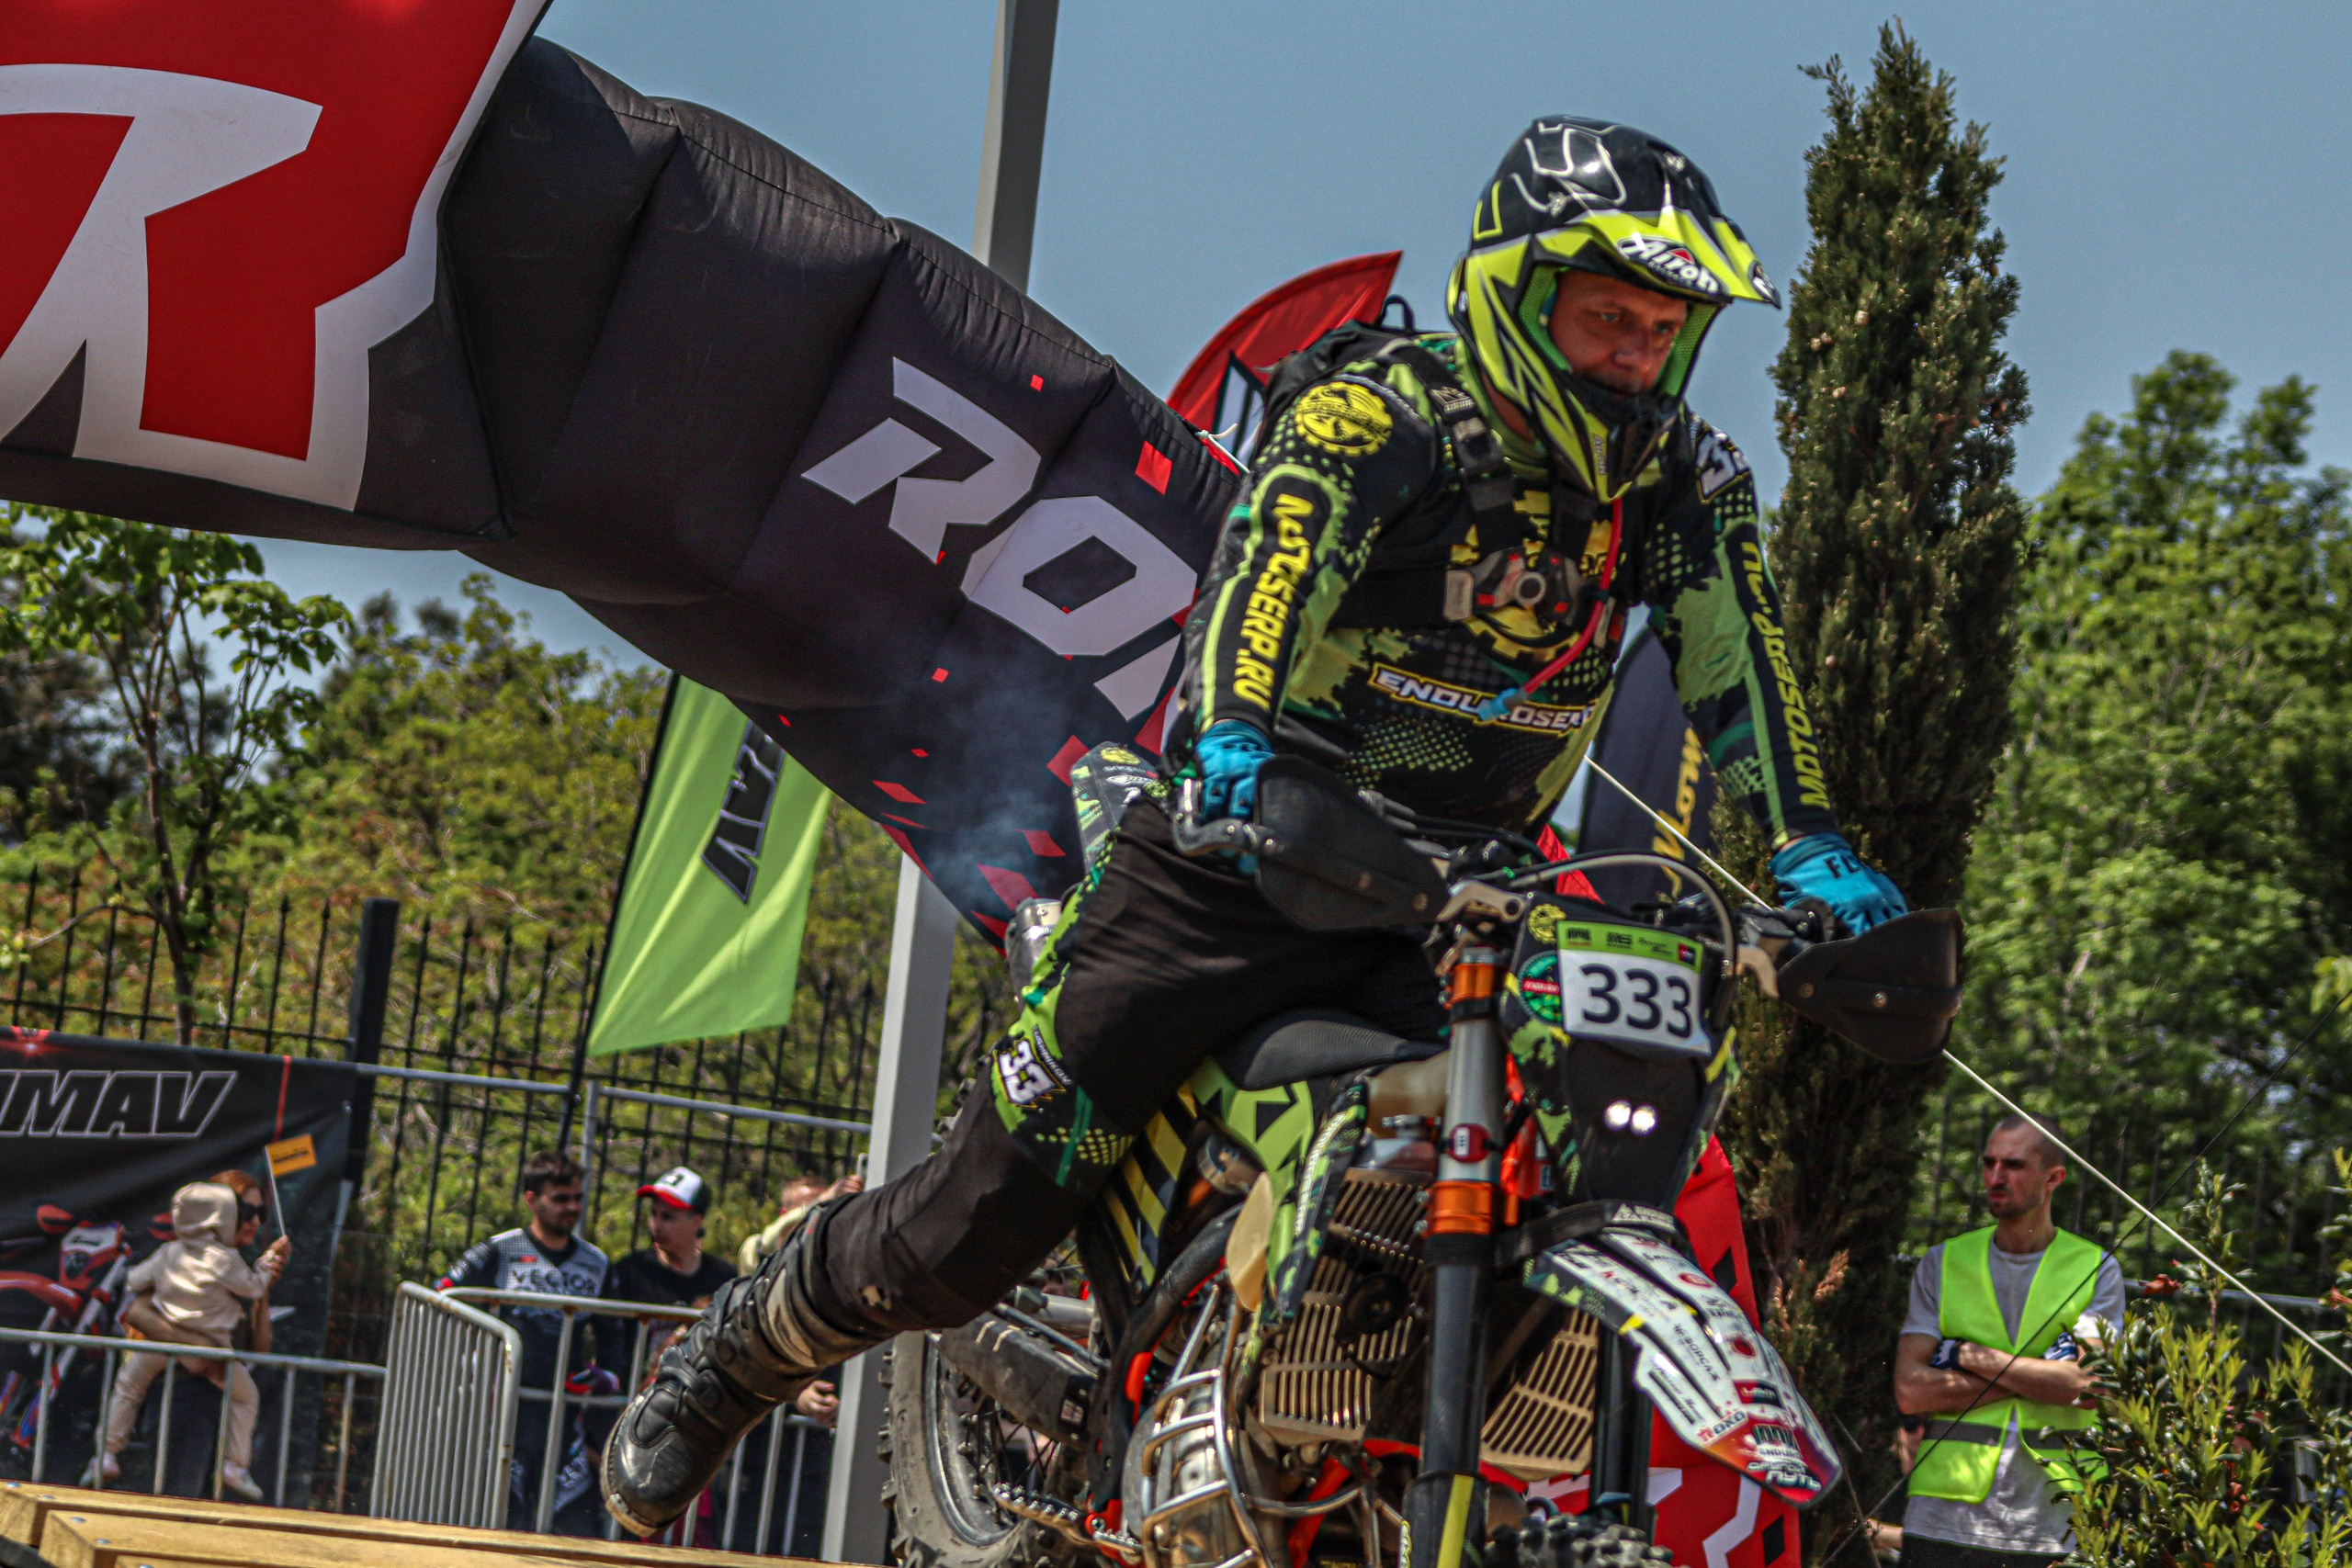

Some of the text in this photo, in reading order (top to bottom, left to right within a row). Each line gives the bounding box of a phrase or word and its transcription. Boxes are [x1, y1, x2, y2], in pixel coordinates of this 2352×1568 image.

[1623, 240, 1719, 294] Airoh
[801, 356, 1198, 750] RO
[1580, 963, 1691, 1038] 333
[0, 1070, 237, 1139] MAV
[512, 1269, 596, 1296] VECTOR
